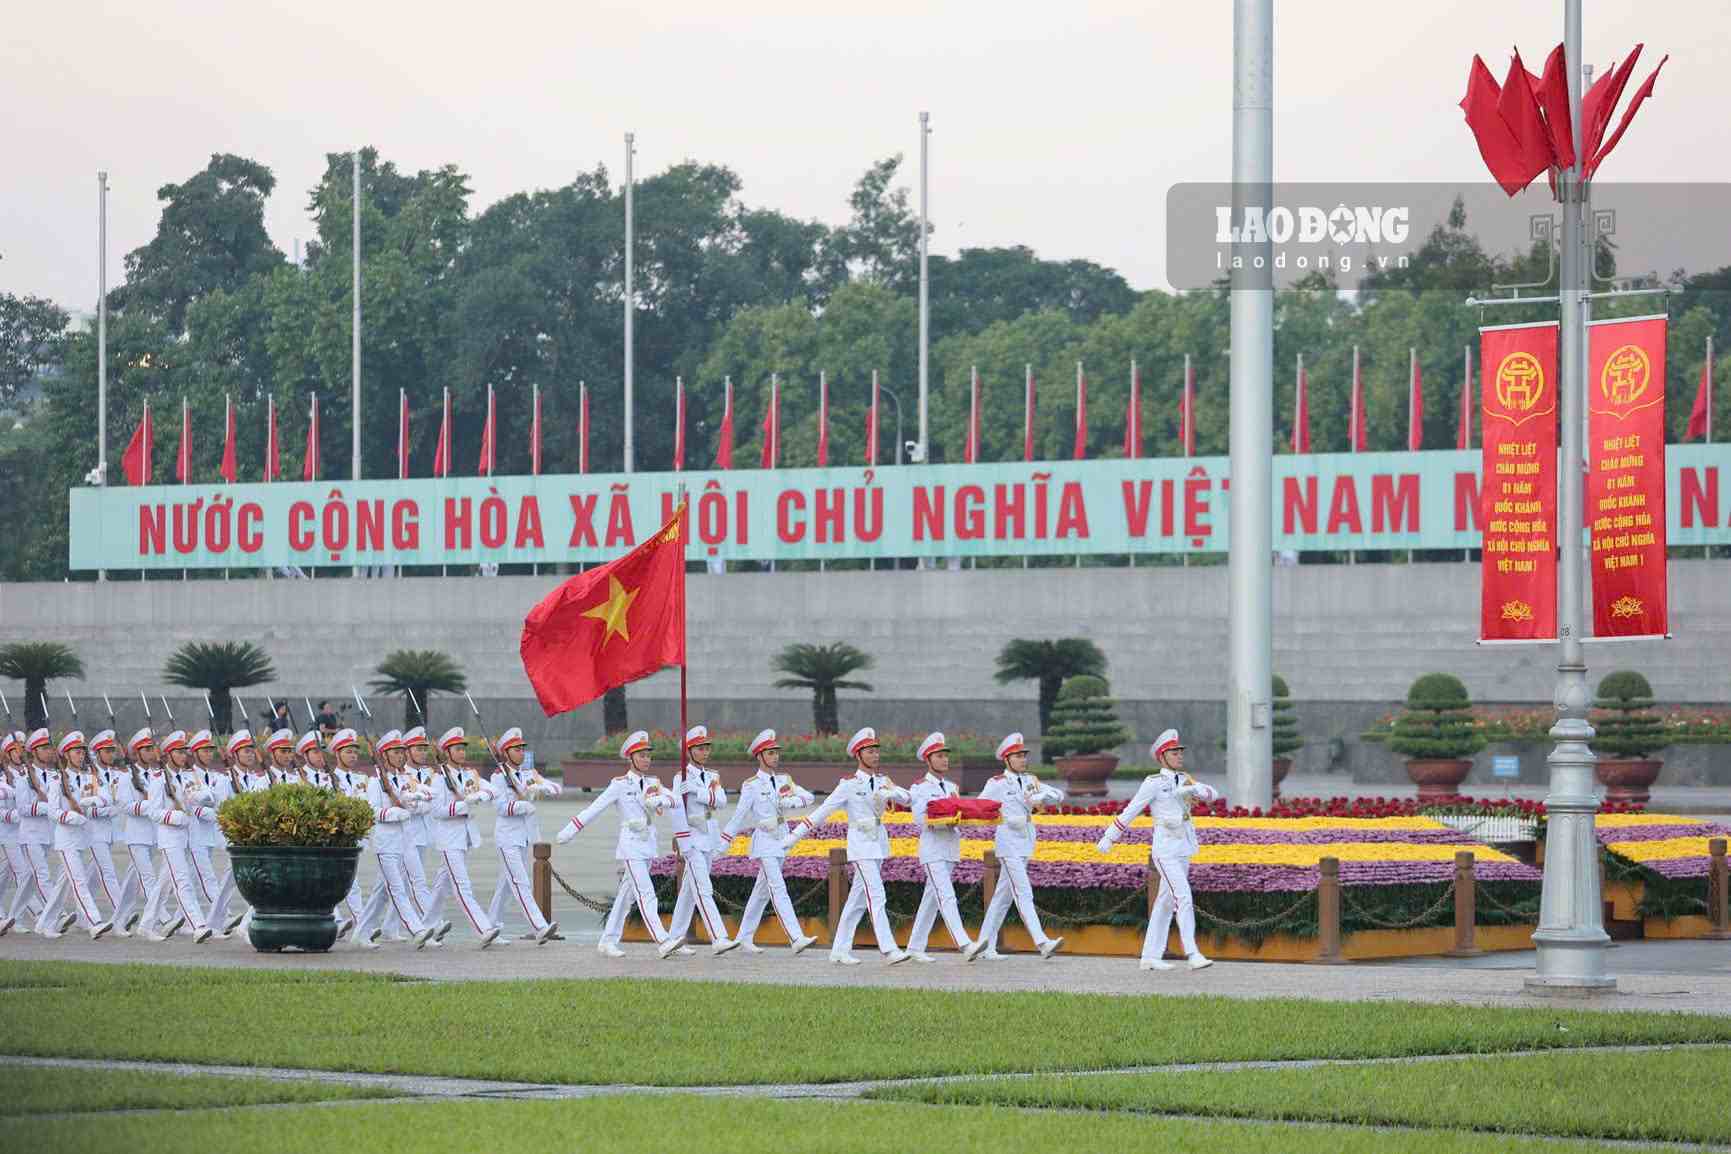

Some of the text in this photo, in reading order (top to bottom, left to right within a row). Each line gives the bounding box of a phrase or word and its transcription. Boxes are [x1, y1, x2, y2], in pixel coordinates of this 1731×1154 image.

[139, 494, 264, 555] NƯỚC
[288, 489, 420, 561] CỘNG
[444, 487, 545, 550] HÒA
[570, 483, 636, 549] XÃ
[777, 470, 884, 544] CHỦ
[912, 473, 1089, 541] NGHĨA
[1121, 467, 1230, 547] VIỆ
[1283, 474, 1420, 535] NAM
[1497, 557, 1513, 573] VIỆT
[1604, 554, 1618, 572] VIỆT
